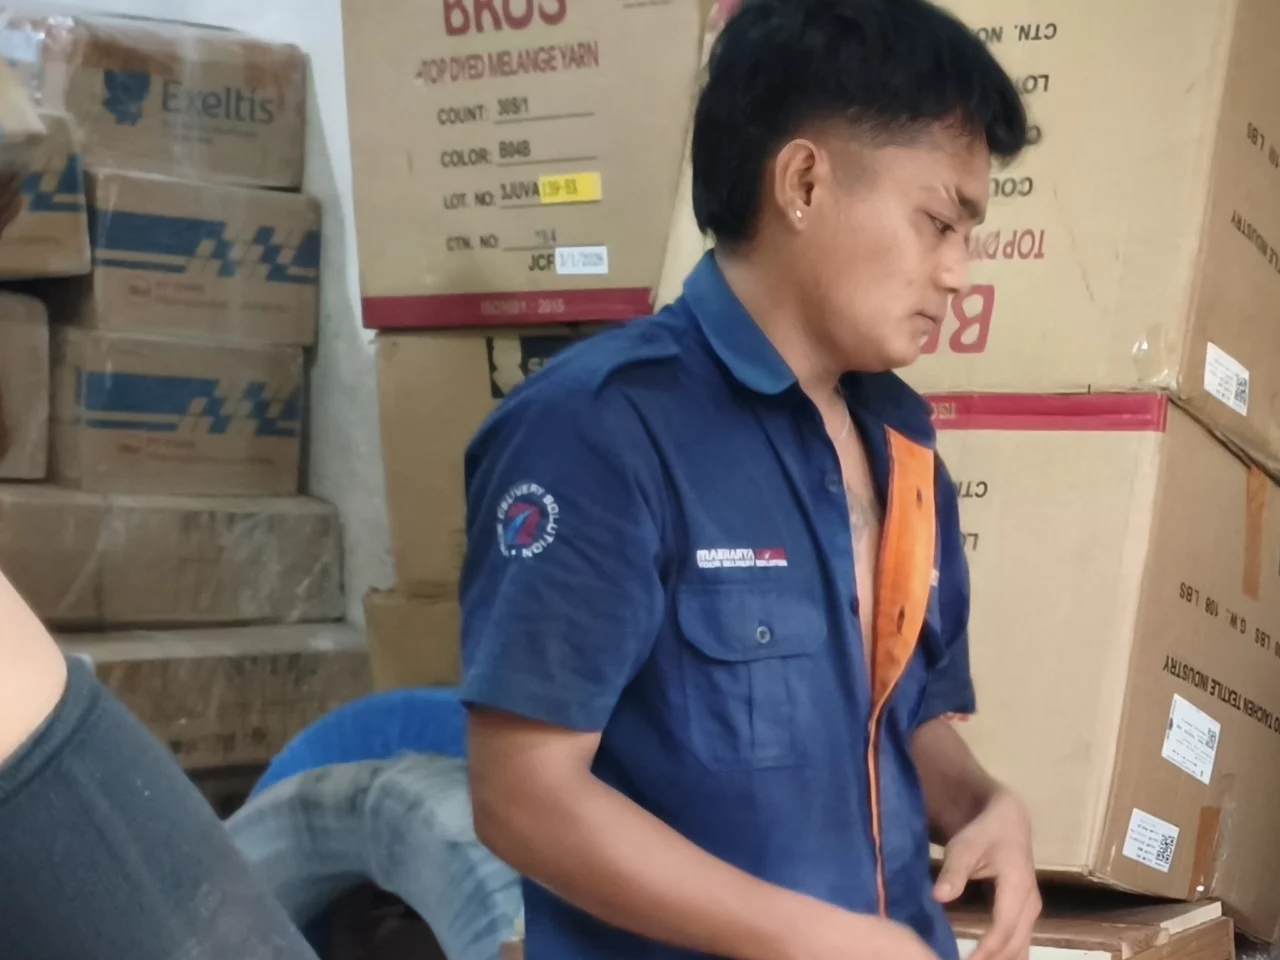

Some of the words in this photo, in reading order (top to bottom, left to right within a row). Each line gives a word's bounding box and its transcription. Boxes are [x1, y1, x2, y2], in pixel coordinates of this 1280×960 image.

[1013, 23, 1057, 41] CTN.
[420, 57, 448, 84] TOP
[450, 53, 485, 81] DYED
[488, 45, 557, 77] MELANGE
[560, 41, 600, 69] YARN
[161, 78, 275, 124] Exeltis
[1246, 122, 1266, 151] LBS
[1002, 228, 1045, 260] TOP
[1230, 208, 1269, 257] INDUSTRY
[521, 493, 560, 558] SOLUTION
[1179, 581, 1200, 607] LBS
[1254, 627, 1271, 651] LBS
[1162, 655, 1210, 692] INDUSTRY
[1209, 677, 1242, 712] TEXTILE
[1243, 696, 1274, 730] TAICHEN
